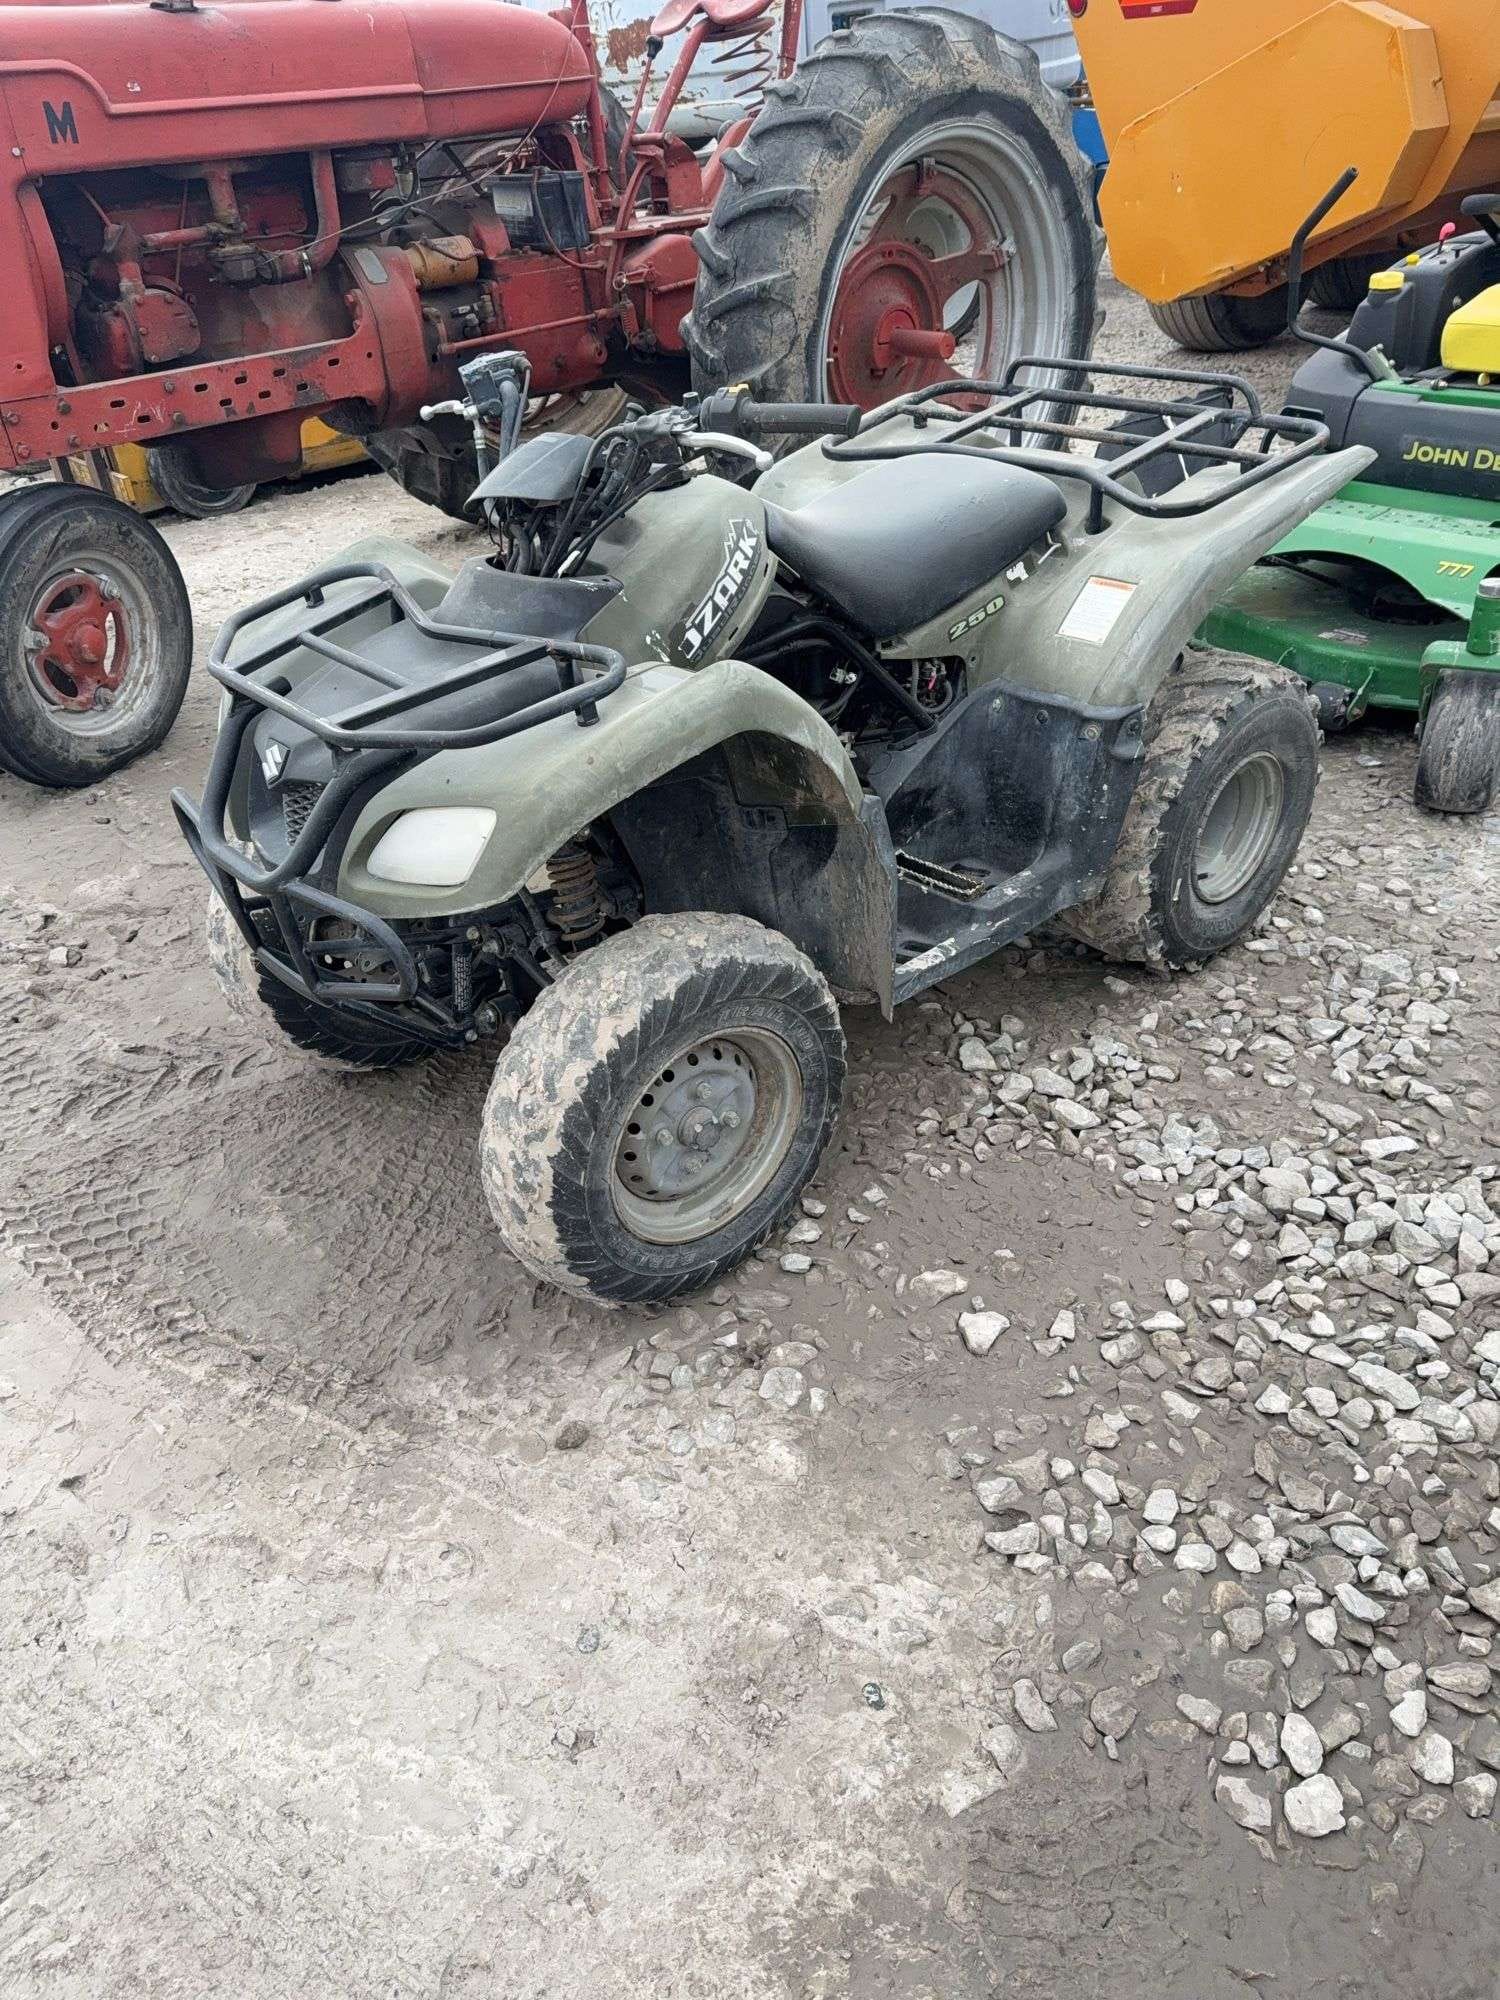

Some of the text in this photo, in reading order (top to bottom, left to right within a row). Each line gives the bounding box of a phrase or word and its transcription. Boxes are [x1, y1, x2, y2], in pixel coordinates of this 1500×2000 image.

[42, 101, 80, 144] M
[1402, 441, 1469, 467] JOHN
[1435, 560, 1475, 577] 777
[948, 595, 1005, 641] 250
